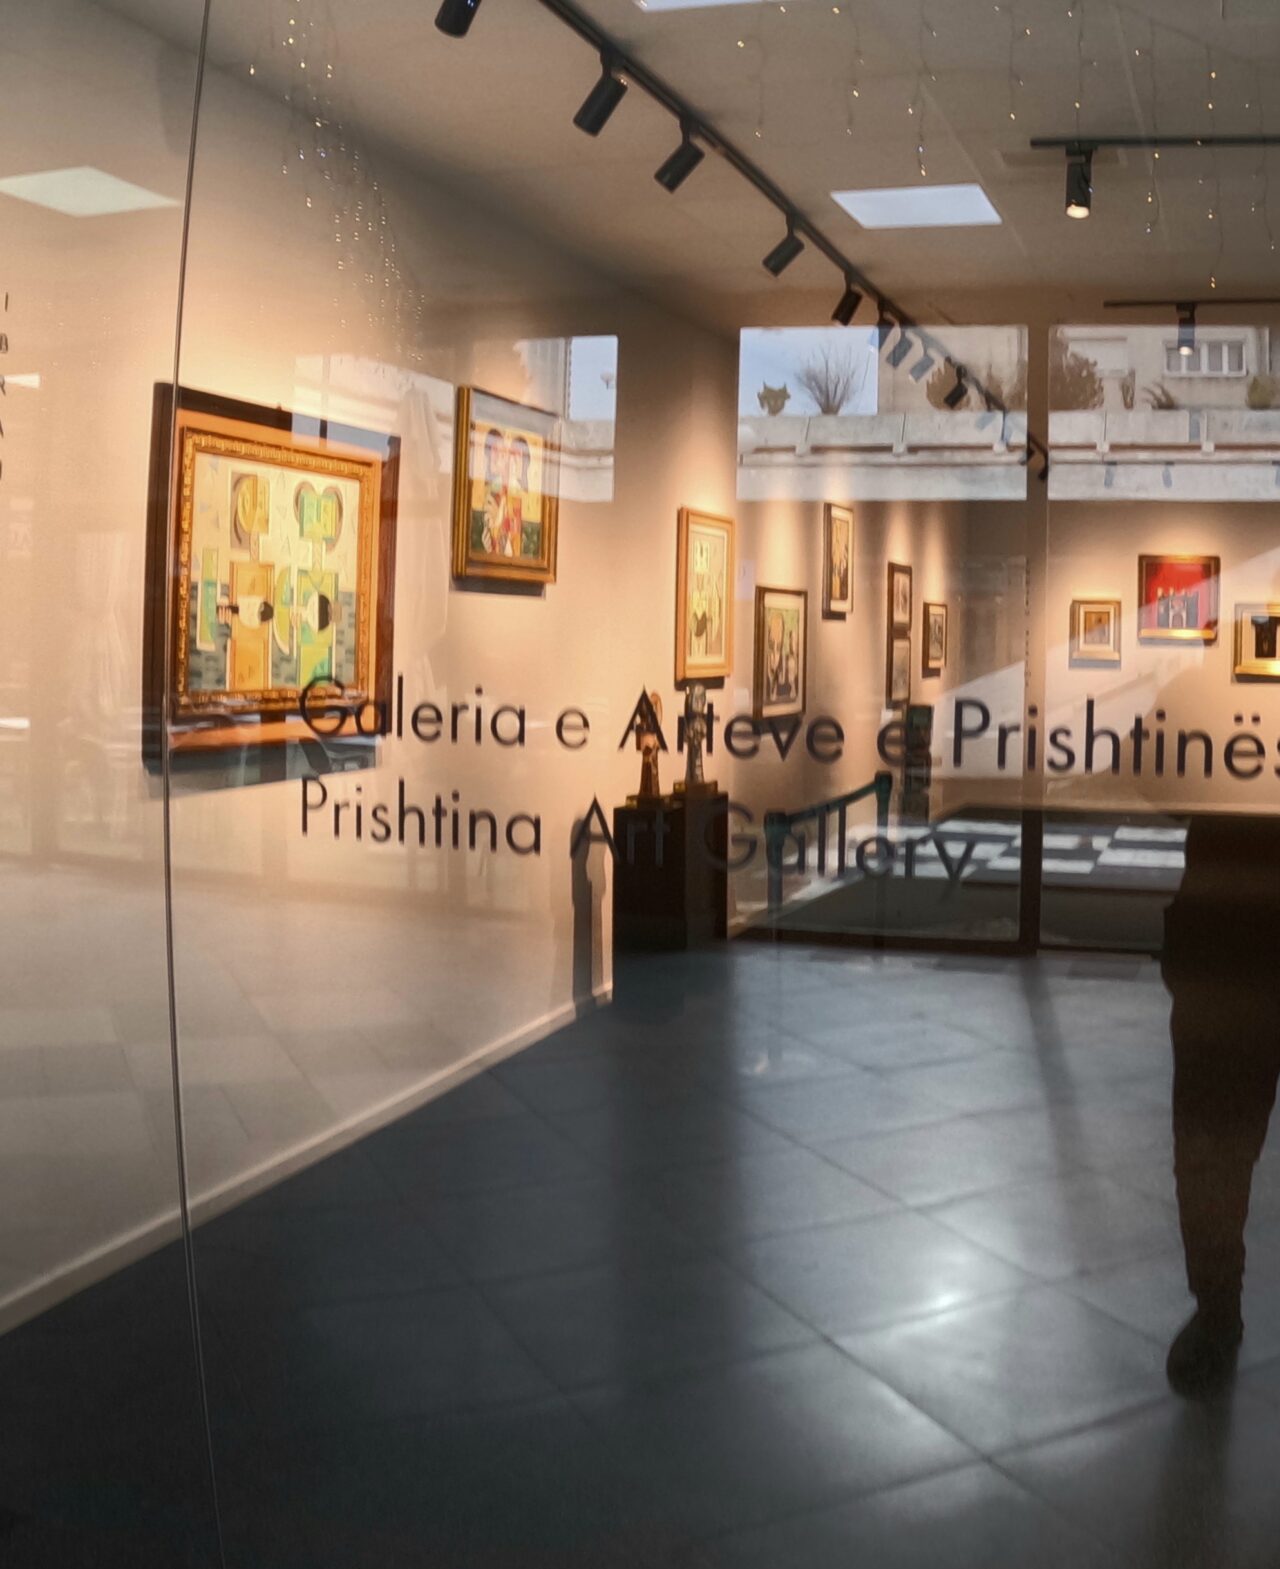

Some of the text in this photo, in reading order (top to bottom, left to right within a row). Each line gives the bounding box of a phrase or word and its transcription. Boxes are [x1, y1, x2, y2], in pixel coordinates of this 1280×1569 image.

[299, 672, 526, 747] Galeria
[555, 707, 590, 750] e
[617, 684, 845, 764] Arteve
[876, 718, 915, 766] e
[301, 776, 977, 902] Prishtina Art Gallery
